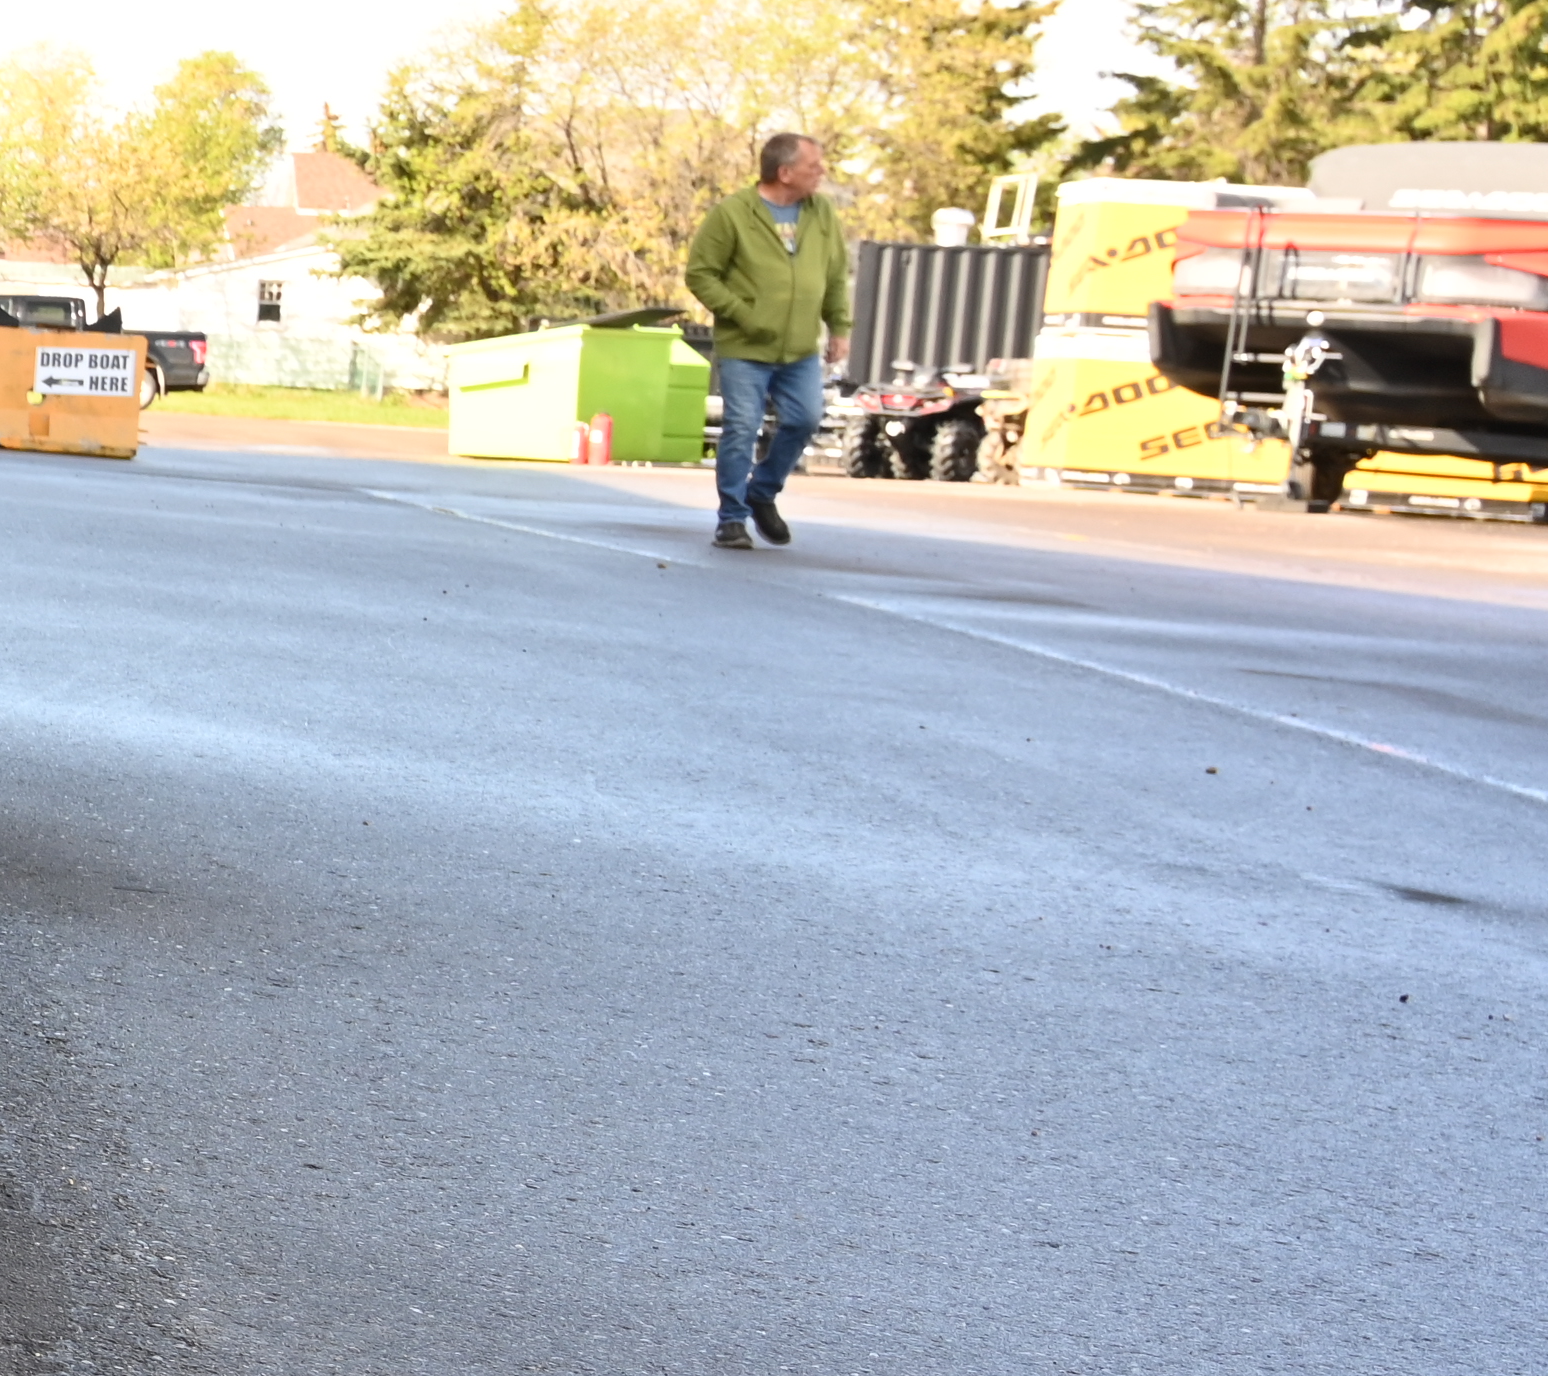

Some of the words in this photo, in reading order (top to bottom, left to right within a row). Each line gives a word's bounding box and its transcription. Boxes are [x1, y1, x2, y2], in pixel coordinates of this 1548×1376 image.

[40, 352, 84, 368] DROP
[88, 354, 129, 370] BOAT
[89, 376, 128, 392] HERE
